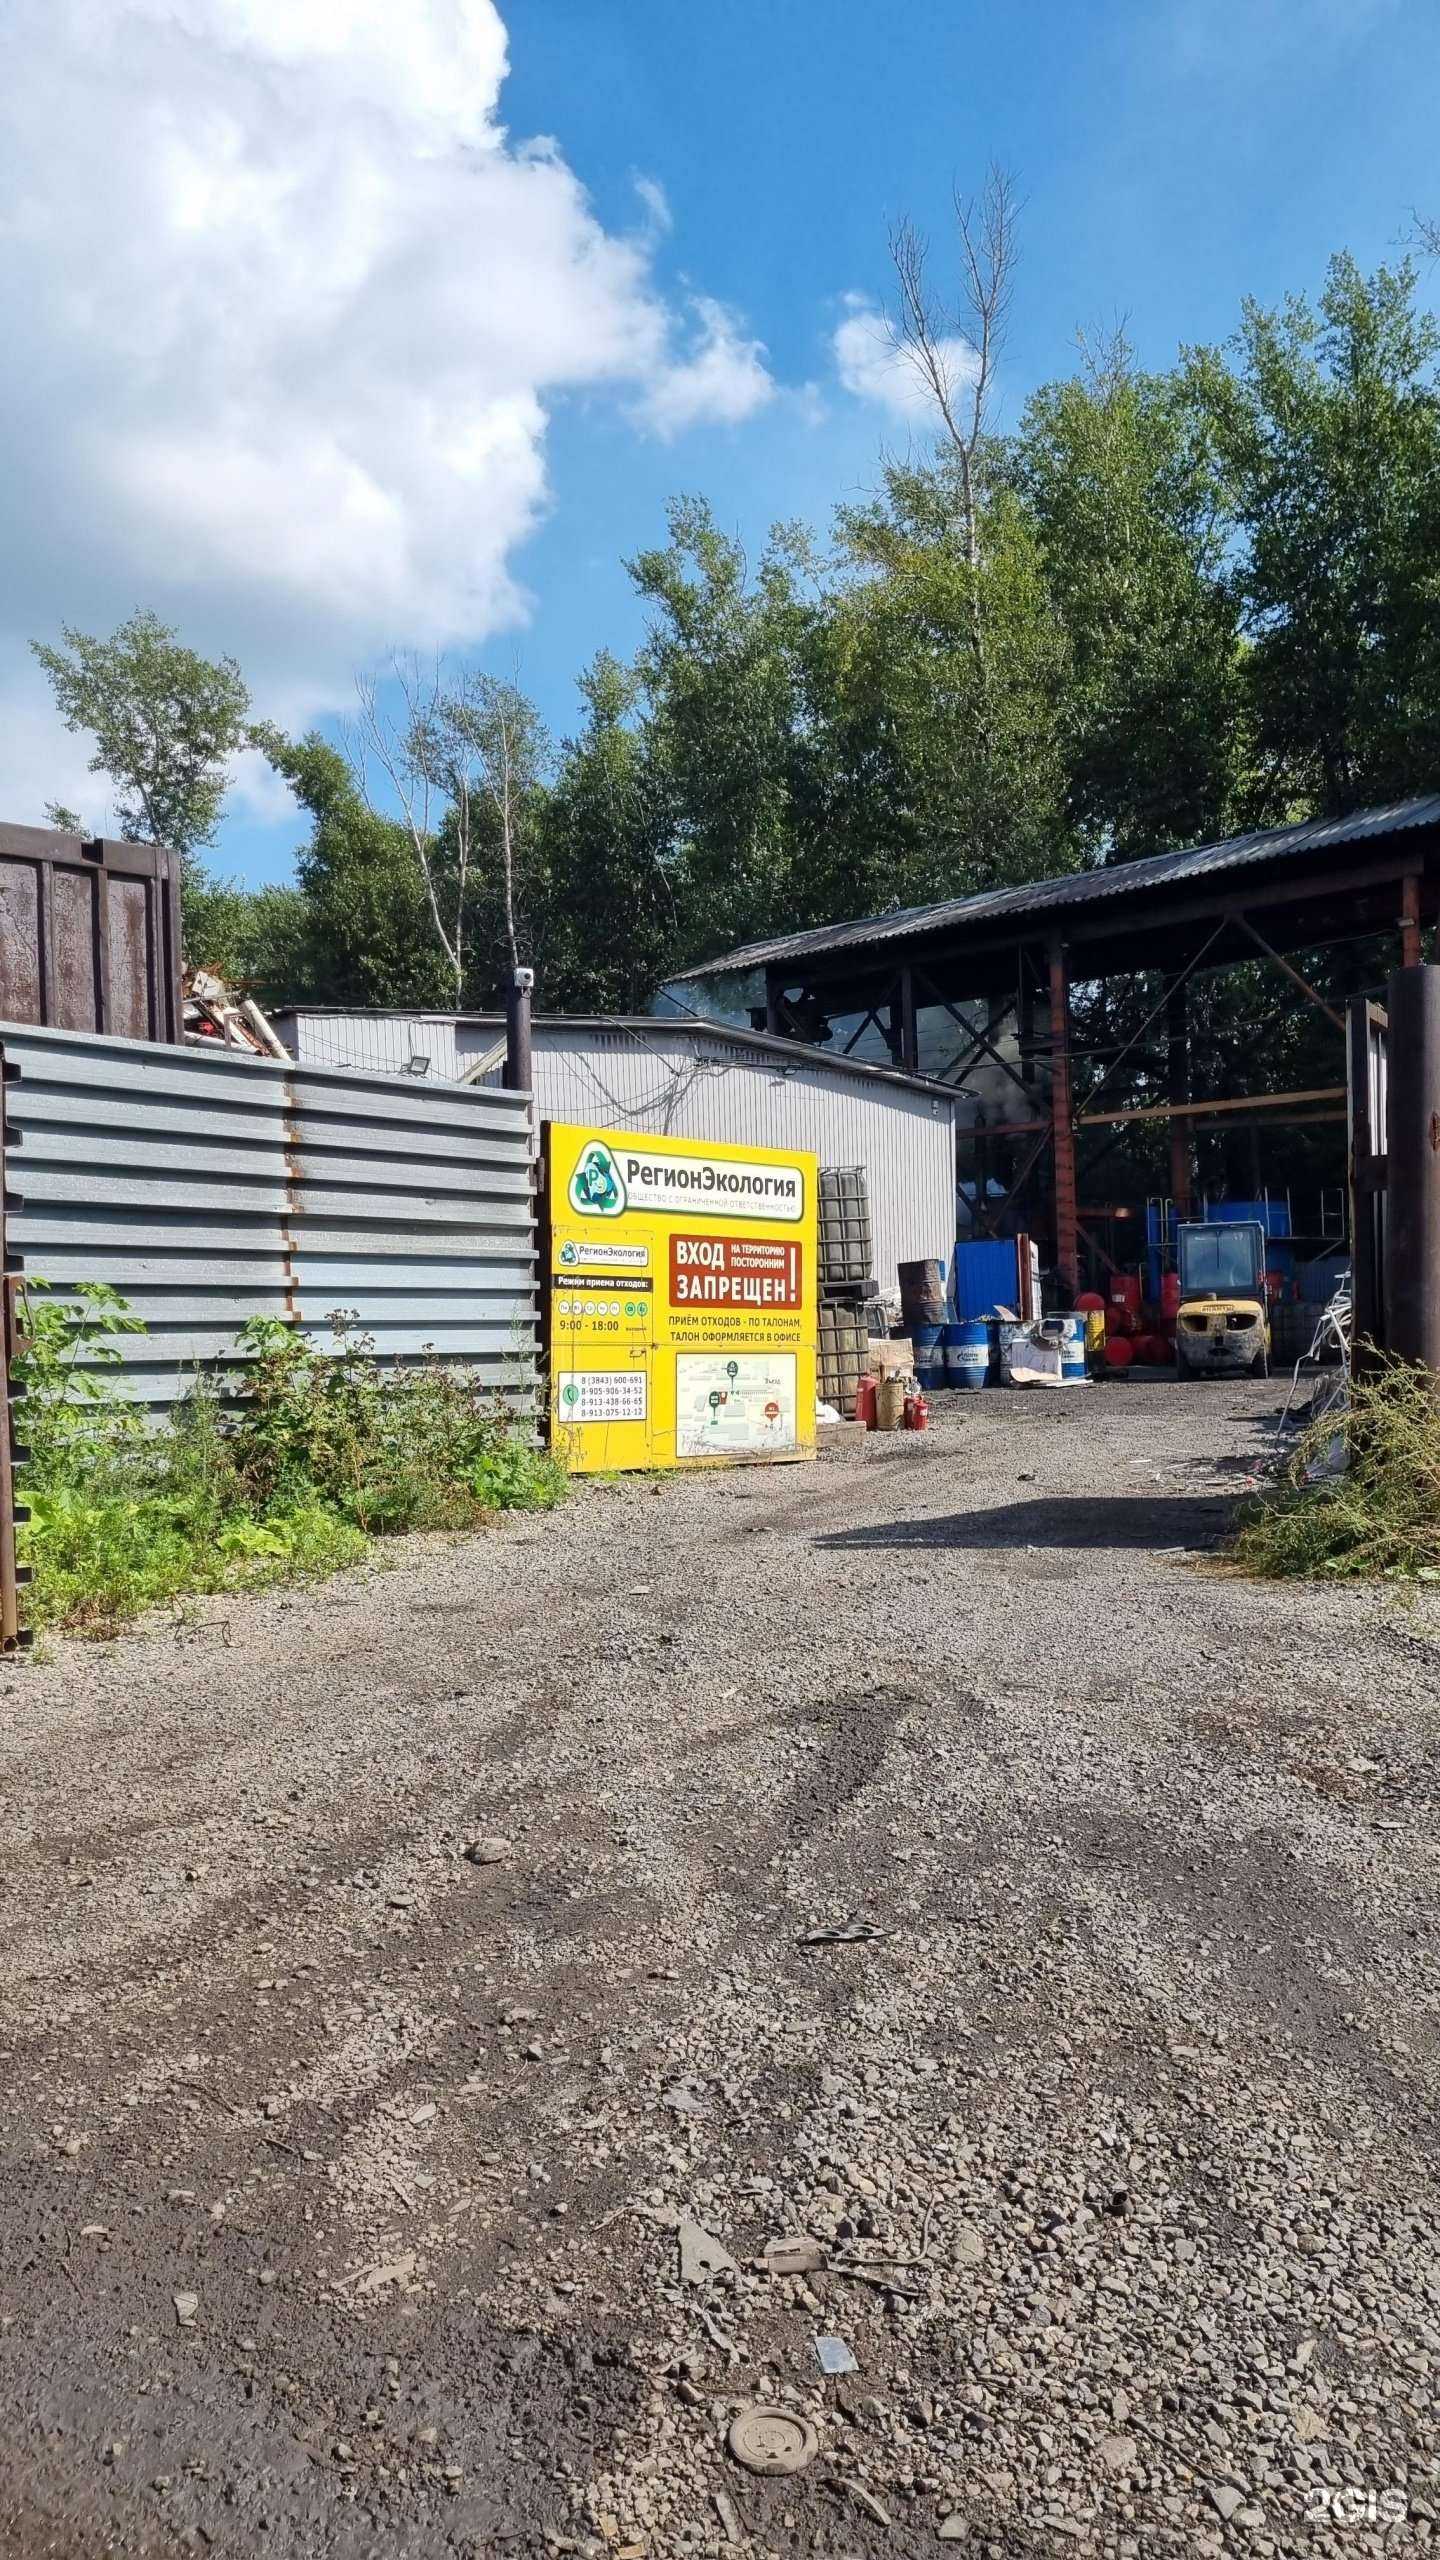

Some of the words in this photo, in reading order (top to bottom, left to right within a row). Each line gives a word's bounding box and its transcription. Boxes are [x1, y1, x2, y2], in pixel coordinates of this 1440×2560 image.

[627, 1159, 796, 1198] РегионЭкология
[579, 1246, 646, 1258] РегионЭкология
[676, 1240, 725, 1271] ВХОД
[731, 1244, 741, 1253] НА
[741, 1245, 785, 1256] ТЕРРИТОРИЮ
[731, 1257, 785, 1269] ПОСТОРОННИМ
[558, 1276, 585, 1287] Режим
[560, 1320, 582, 1330] 9:00
[592, 1320, 619, 1331] 18:00
[669, 1314, 699, 1326] ПРИЁМ
[701, 1316, 741, 1327] ОТХОДОВ
[749, 1318, 760, 1327] ПО
[671, 1332, 699, 1341] ТАЛОН
[702, 1331, 764, 1342] ОФОРМЛЯЕТСЯ
[767, 1333, 772, 1341] В
[774, 1332, 801, 1342] ОФИСЕ
